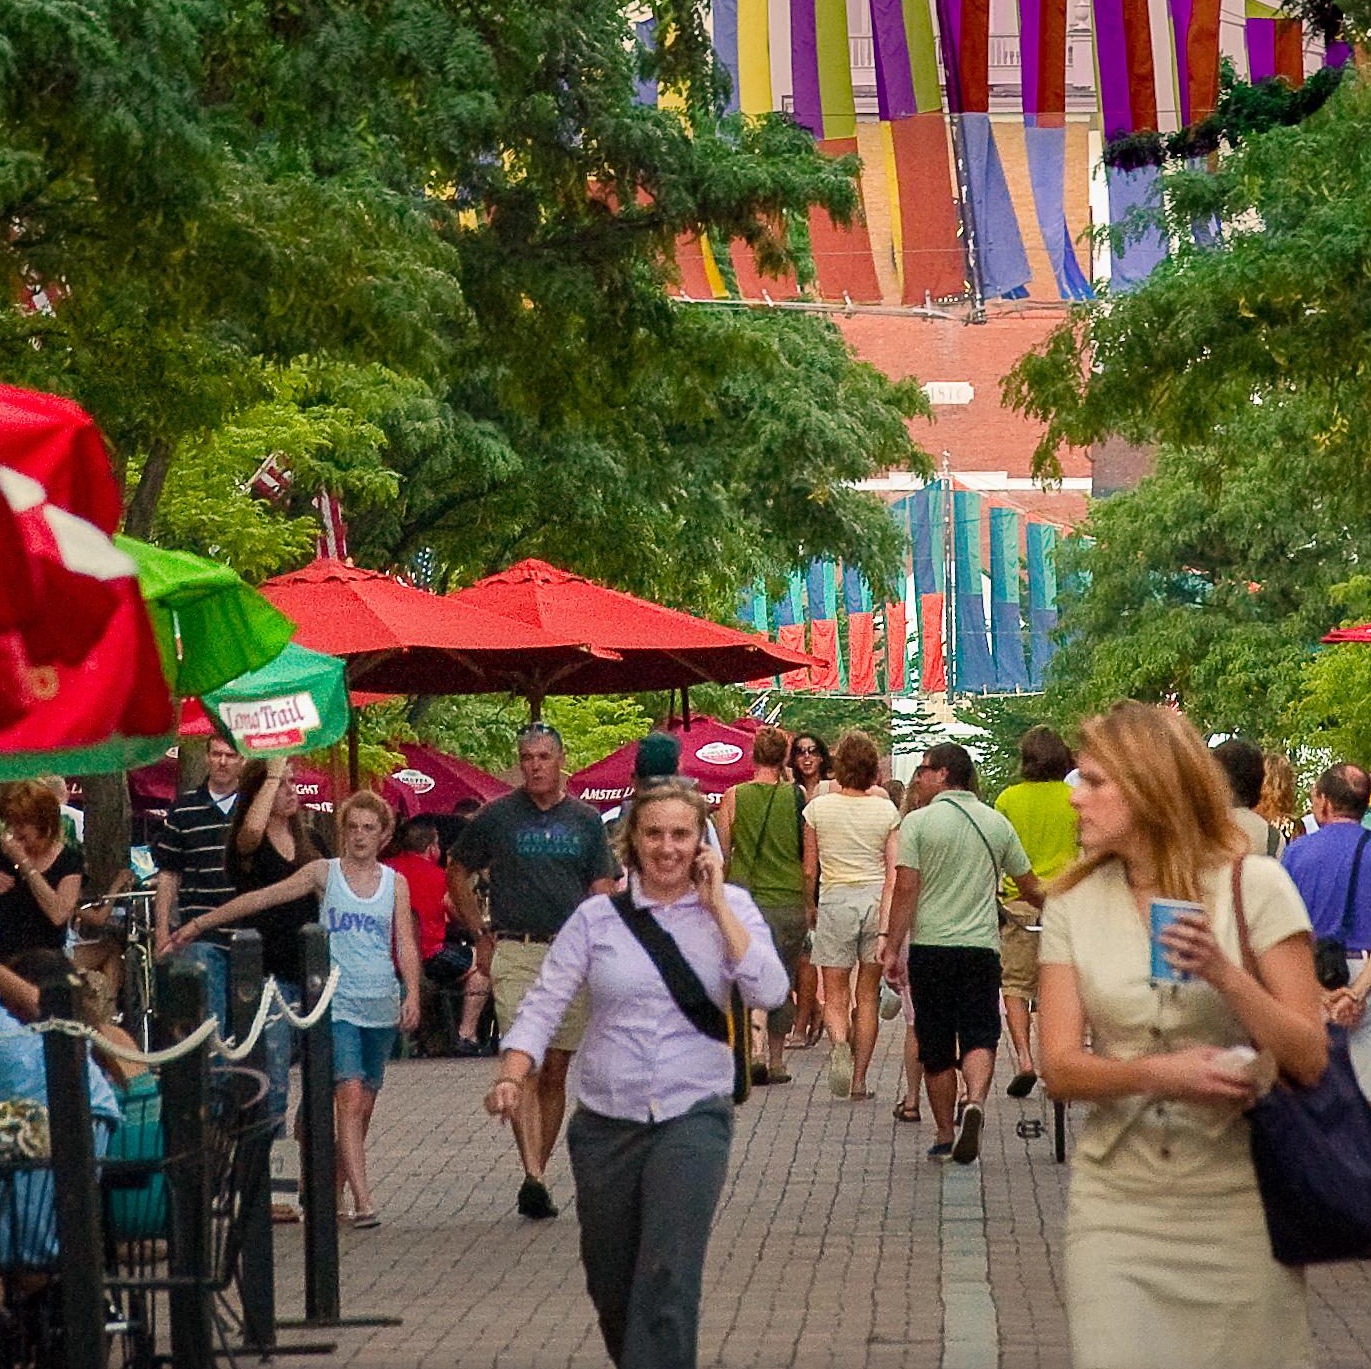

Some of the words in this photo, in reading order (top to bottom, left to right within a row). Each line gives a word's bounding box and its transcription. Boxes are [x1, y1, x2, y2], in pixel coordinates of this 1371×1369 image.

[259, 695, 304, 730] Trail
[579, 787, 622, 801] AMSTEL
[328, 906, 376, 933] Love
